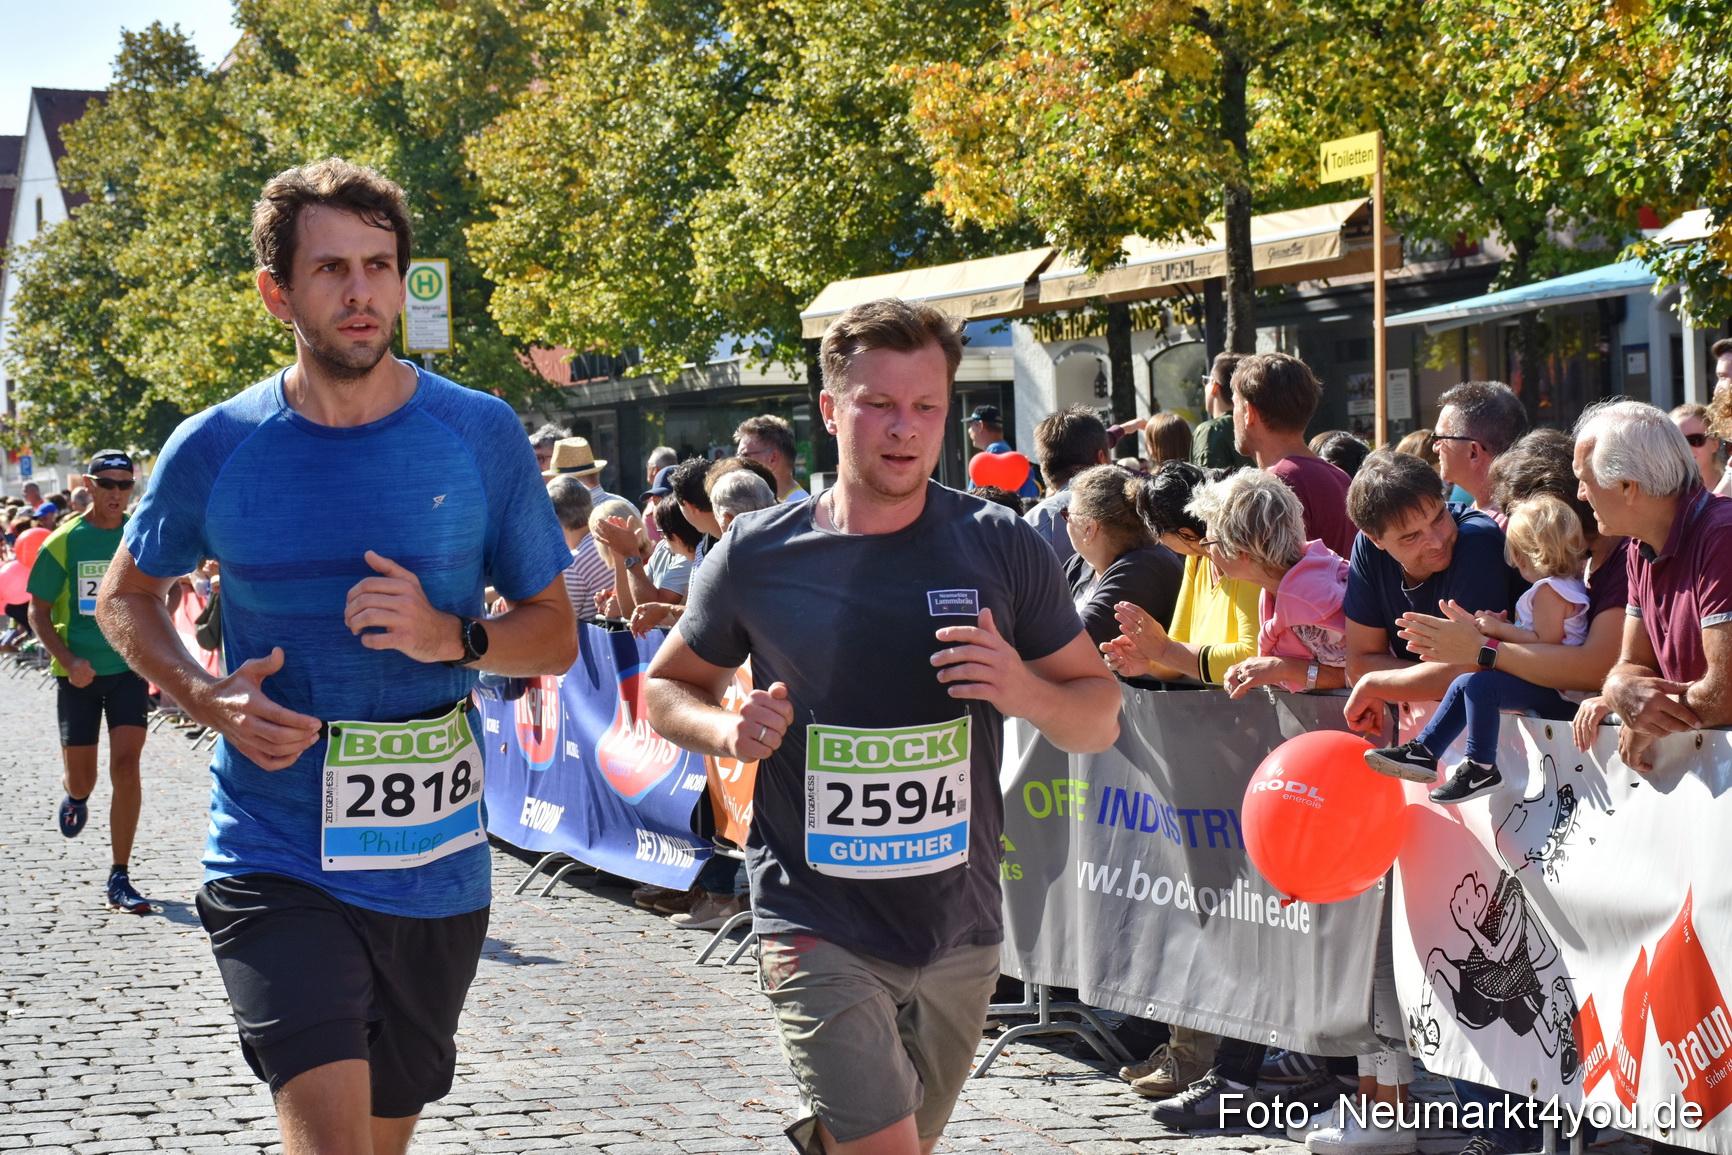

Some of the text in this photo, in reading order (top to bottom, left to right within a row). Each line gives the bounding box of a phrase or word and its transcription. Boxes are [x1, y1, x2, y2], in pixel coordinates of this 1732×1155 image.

[1331, 147, 1374, 169] Toiletten
[417, 274, 433, 293] H
[85, 565, 109, 575] BO
[343, 716, 464, 759] BOCK
[822, 729, 958, 765] BOCK
[346, 760, 471, 818] 2818
[959, 773, 965, 782] C
[1252, 768, 1324, 802] RÖDL
[826, 775, 956, 827] 2594
[1282, 793, 1322, 809] energie
[359, 830, 443, 856] Philipp
[635, 828, 657, 862] GET
[830, 833, 953, 862] GÜNTHER
[1582, 1041, 1605, 1082] raun
[1661, 1005, 1732, 1094] Braun
[1705, 1066, 1728, 1089] Sicher
